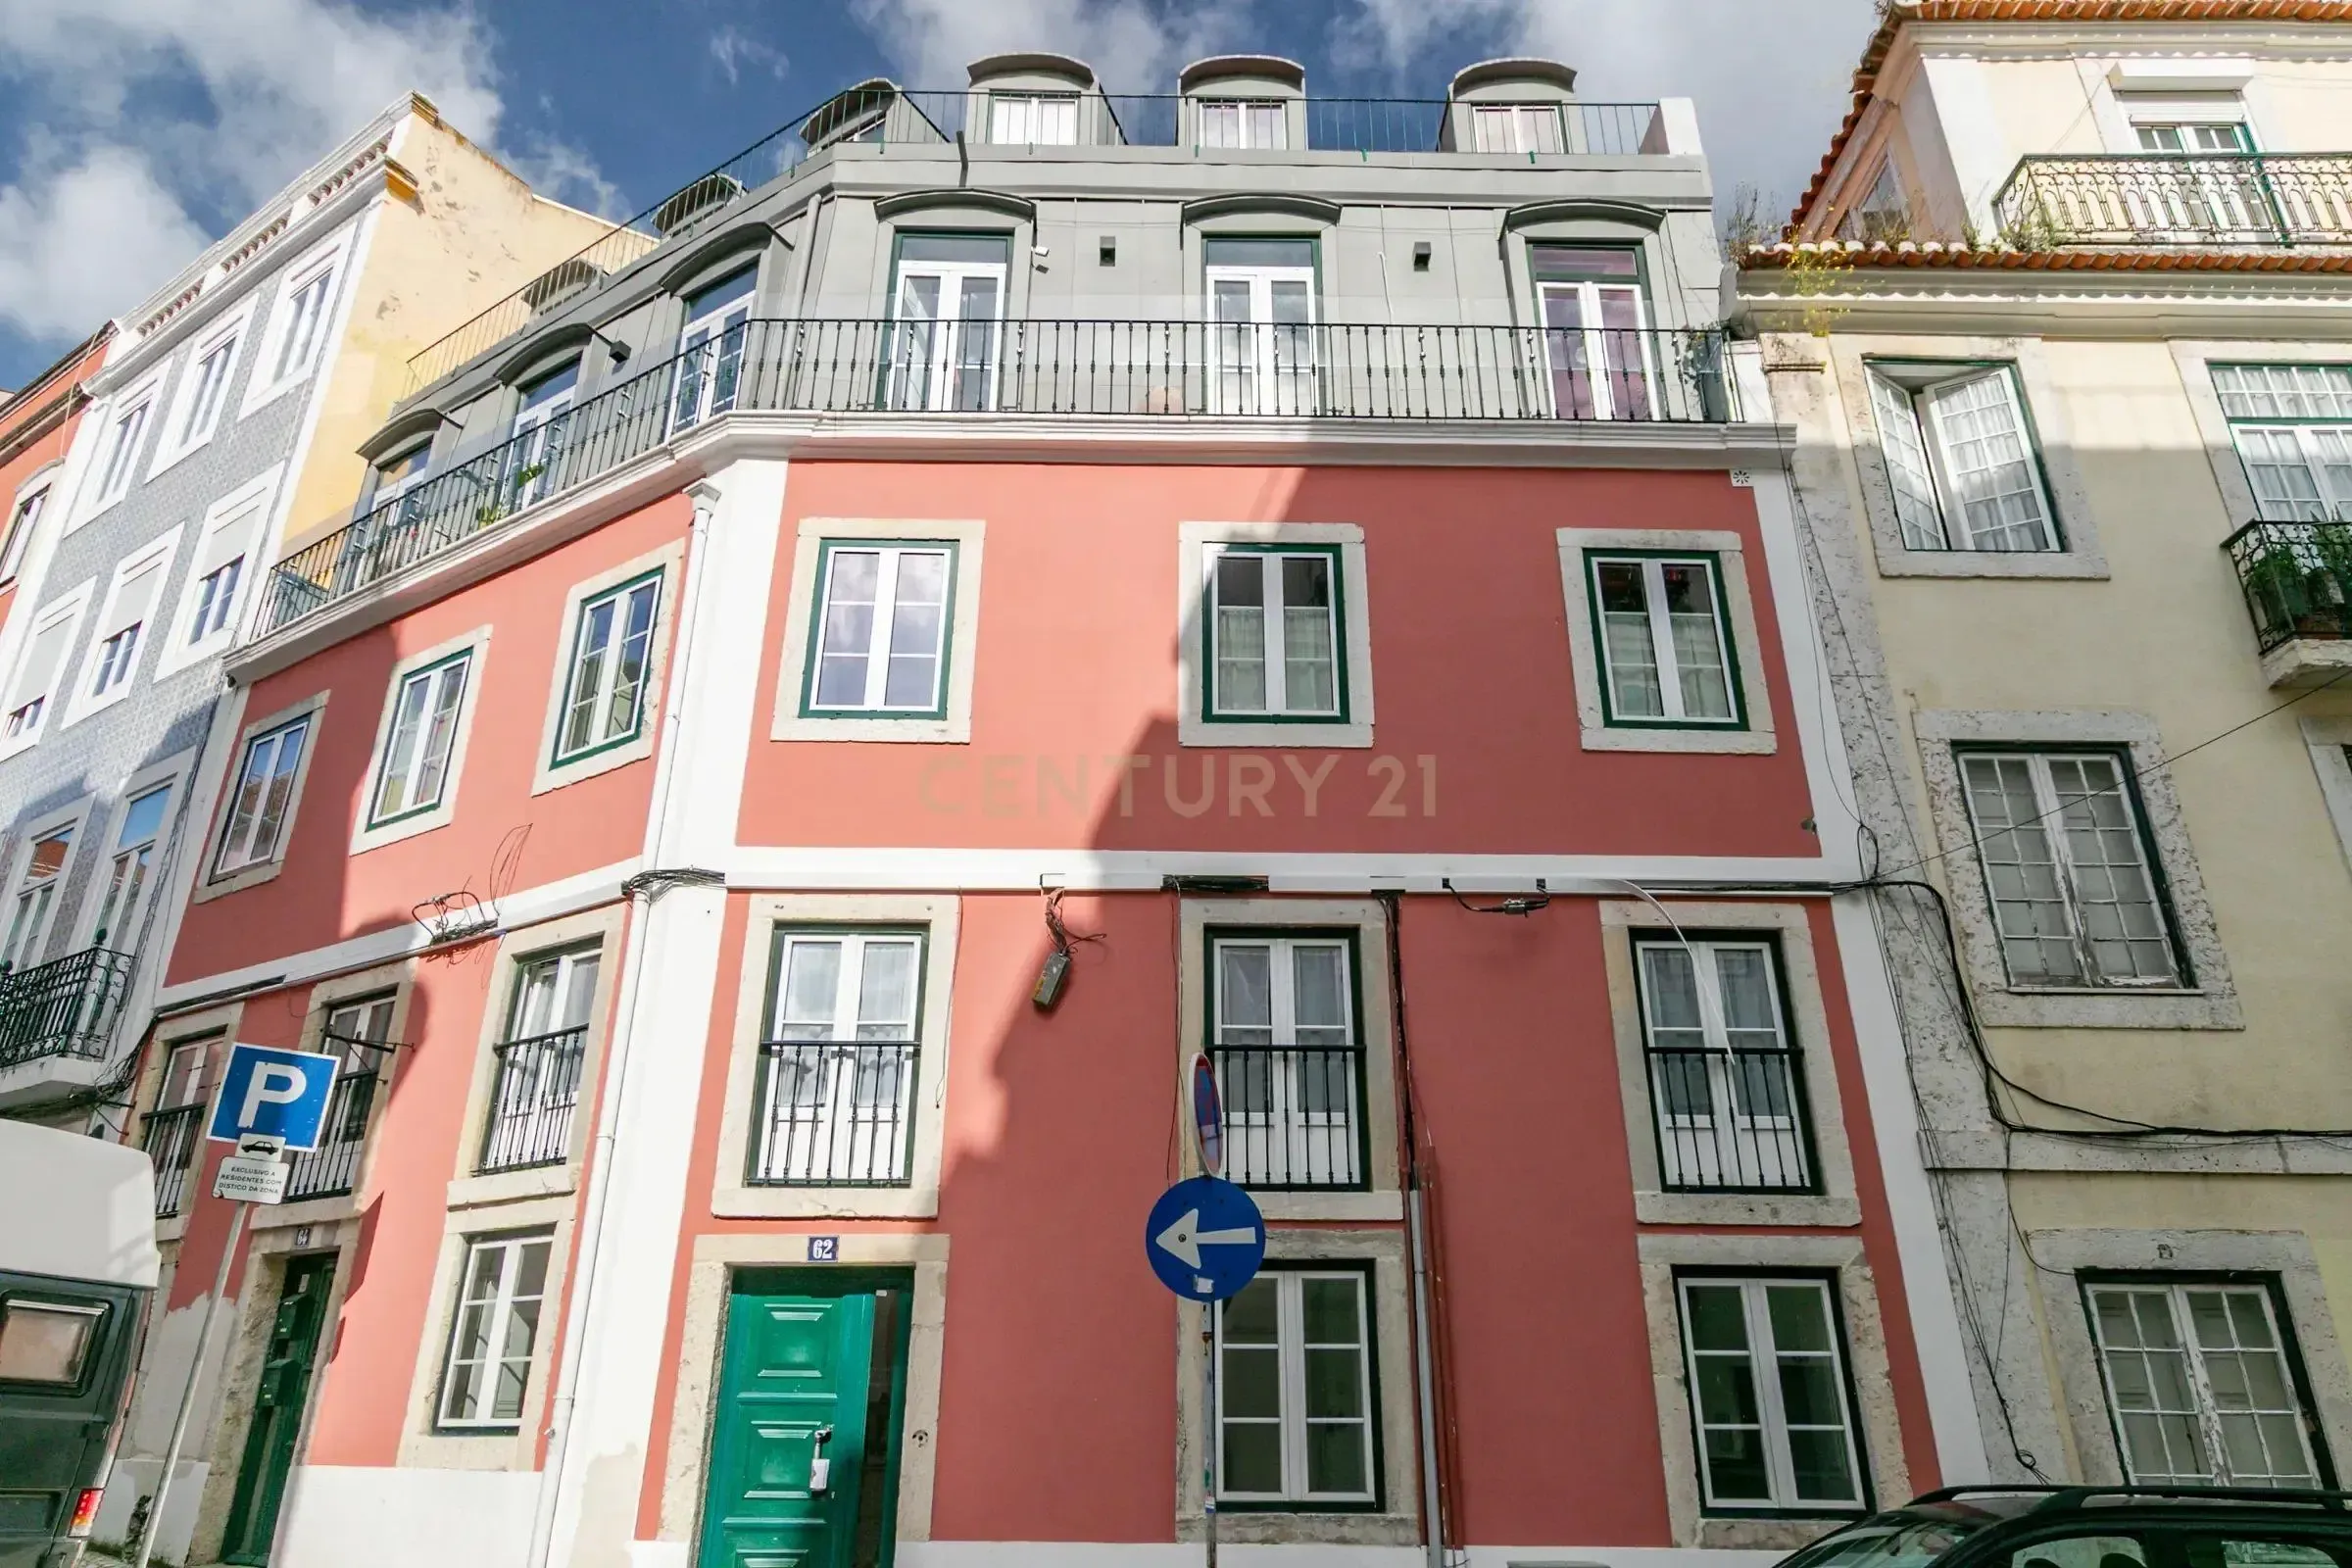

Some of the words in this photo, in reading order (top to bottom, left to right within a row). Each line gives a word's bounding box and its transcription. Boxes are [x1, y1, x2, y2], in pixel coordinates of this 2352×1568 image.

[237, 1060, 308, 1129] P
[231, 1166, 270, 1176] EXCLUSIVO
[220, 1174, 264, 1184] RESIDENTES
[812, 1239, 833, 1259] 62
